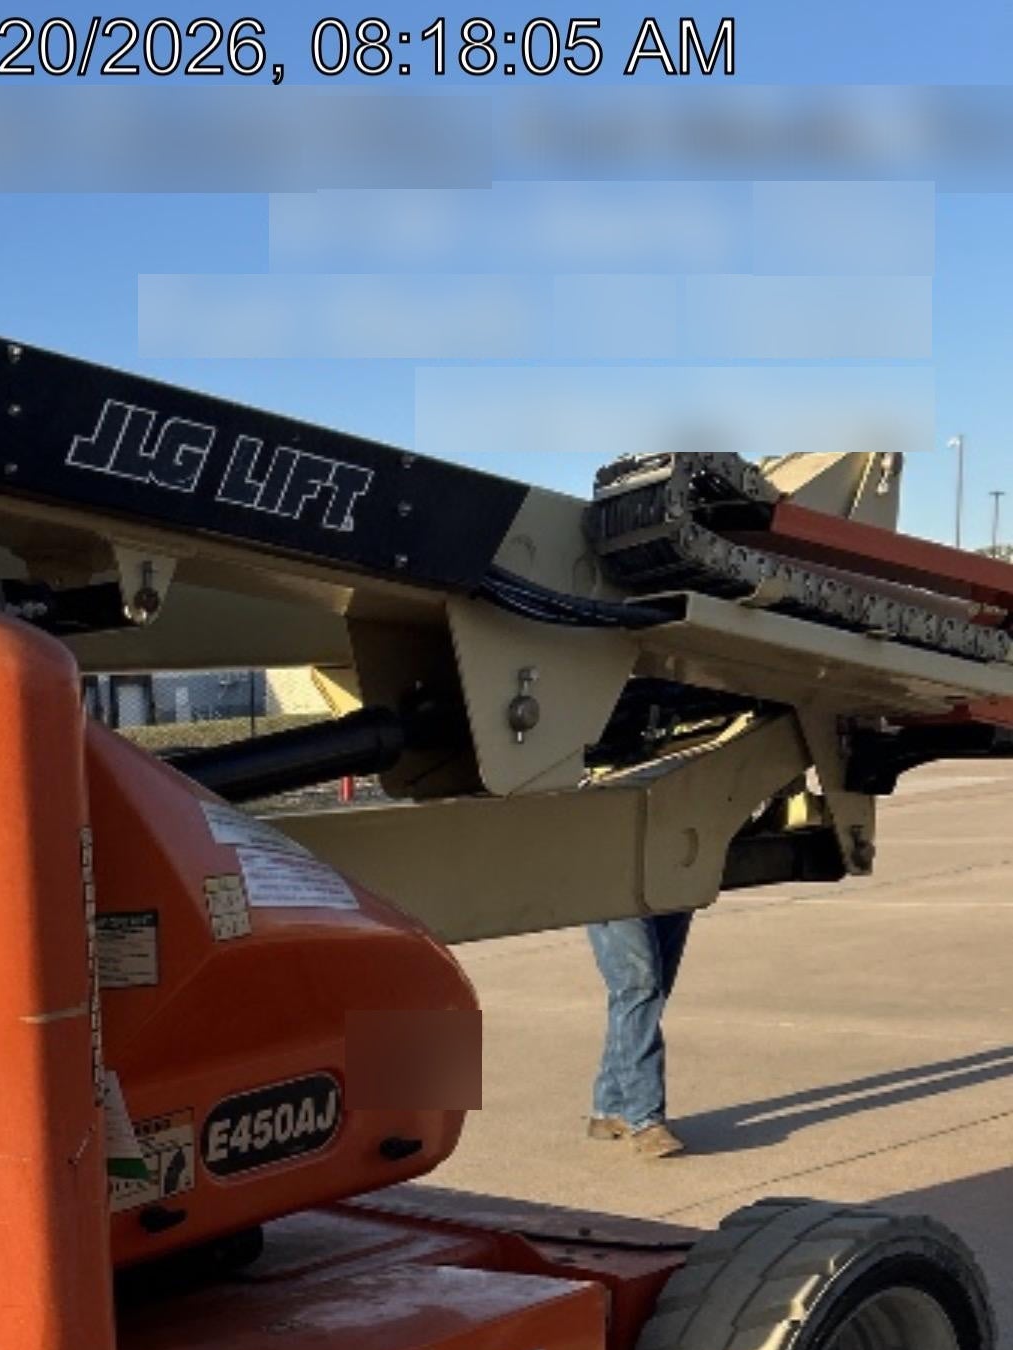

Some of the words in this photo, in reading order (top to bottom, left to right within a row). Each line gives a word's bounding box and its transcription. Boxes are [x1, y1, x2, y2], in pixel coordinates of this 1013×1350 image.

[65, 397, 217, 494] JLG
[214, 433, 376, 533] LIFT
[205, 1087, 337, 1163] E450AJ
